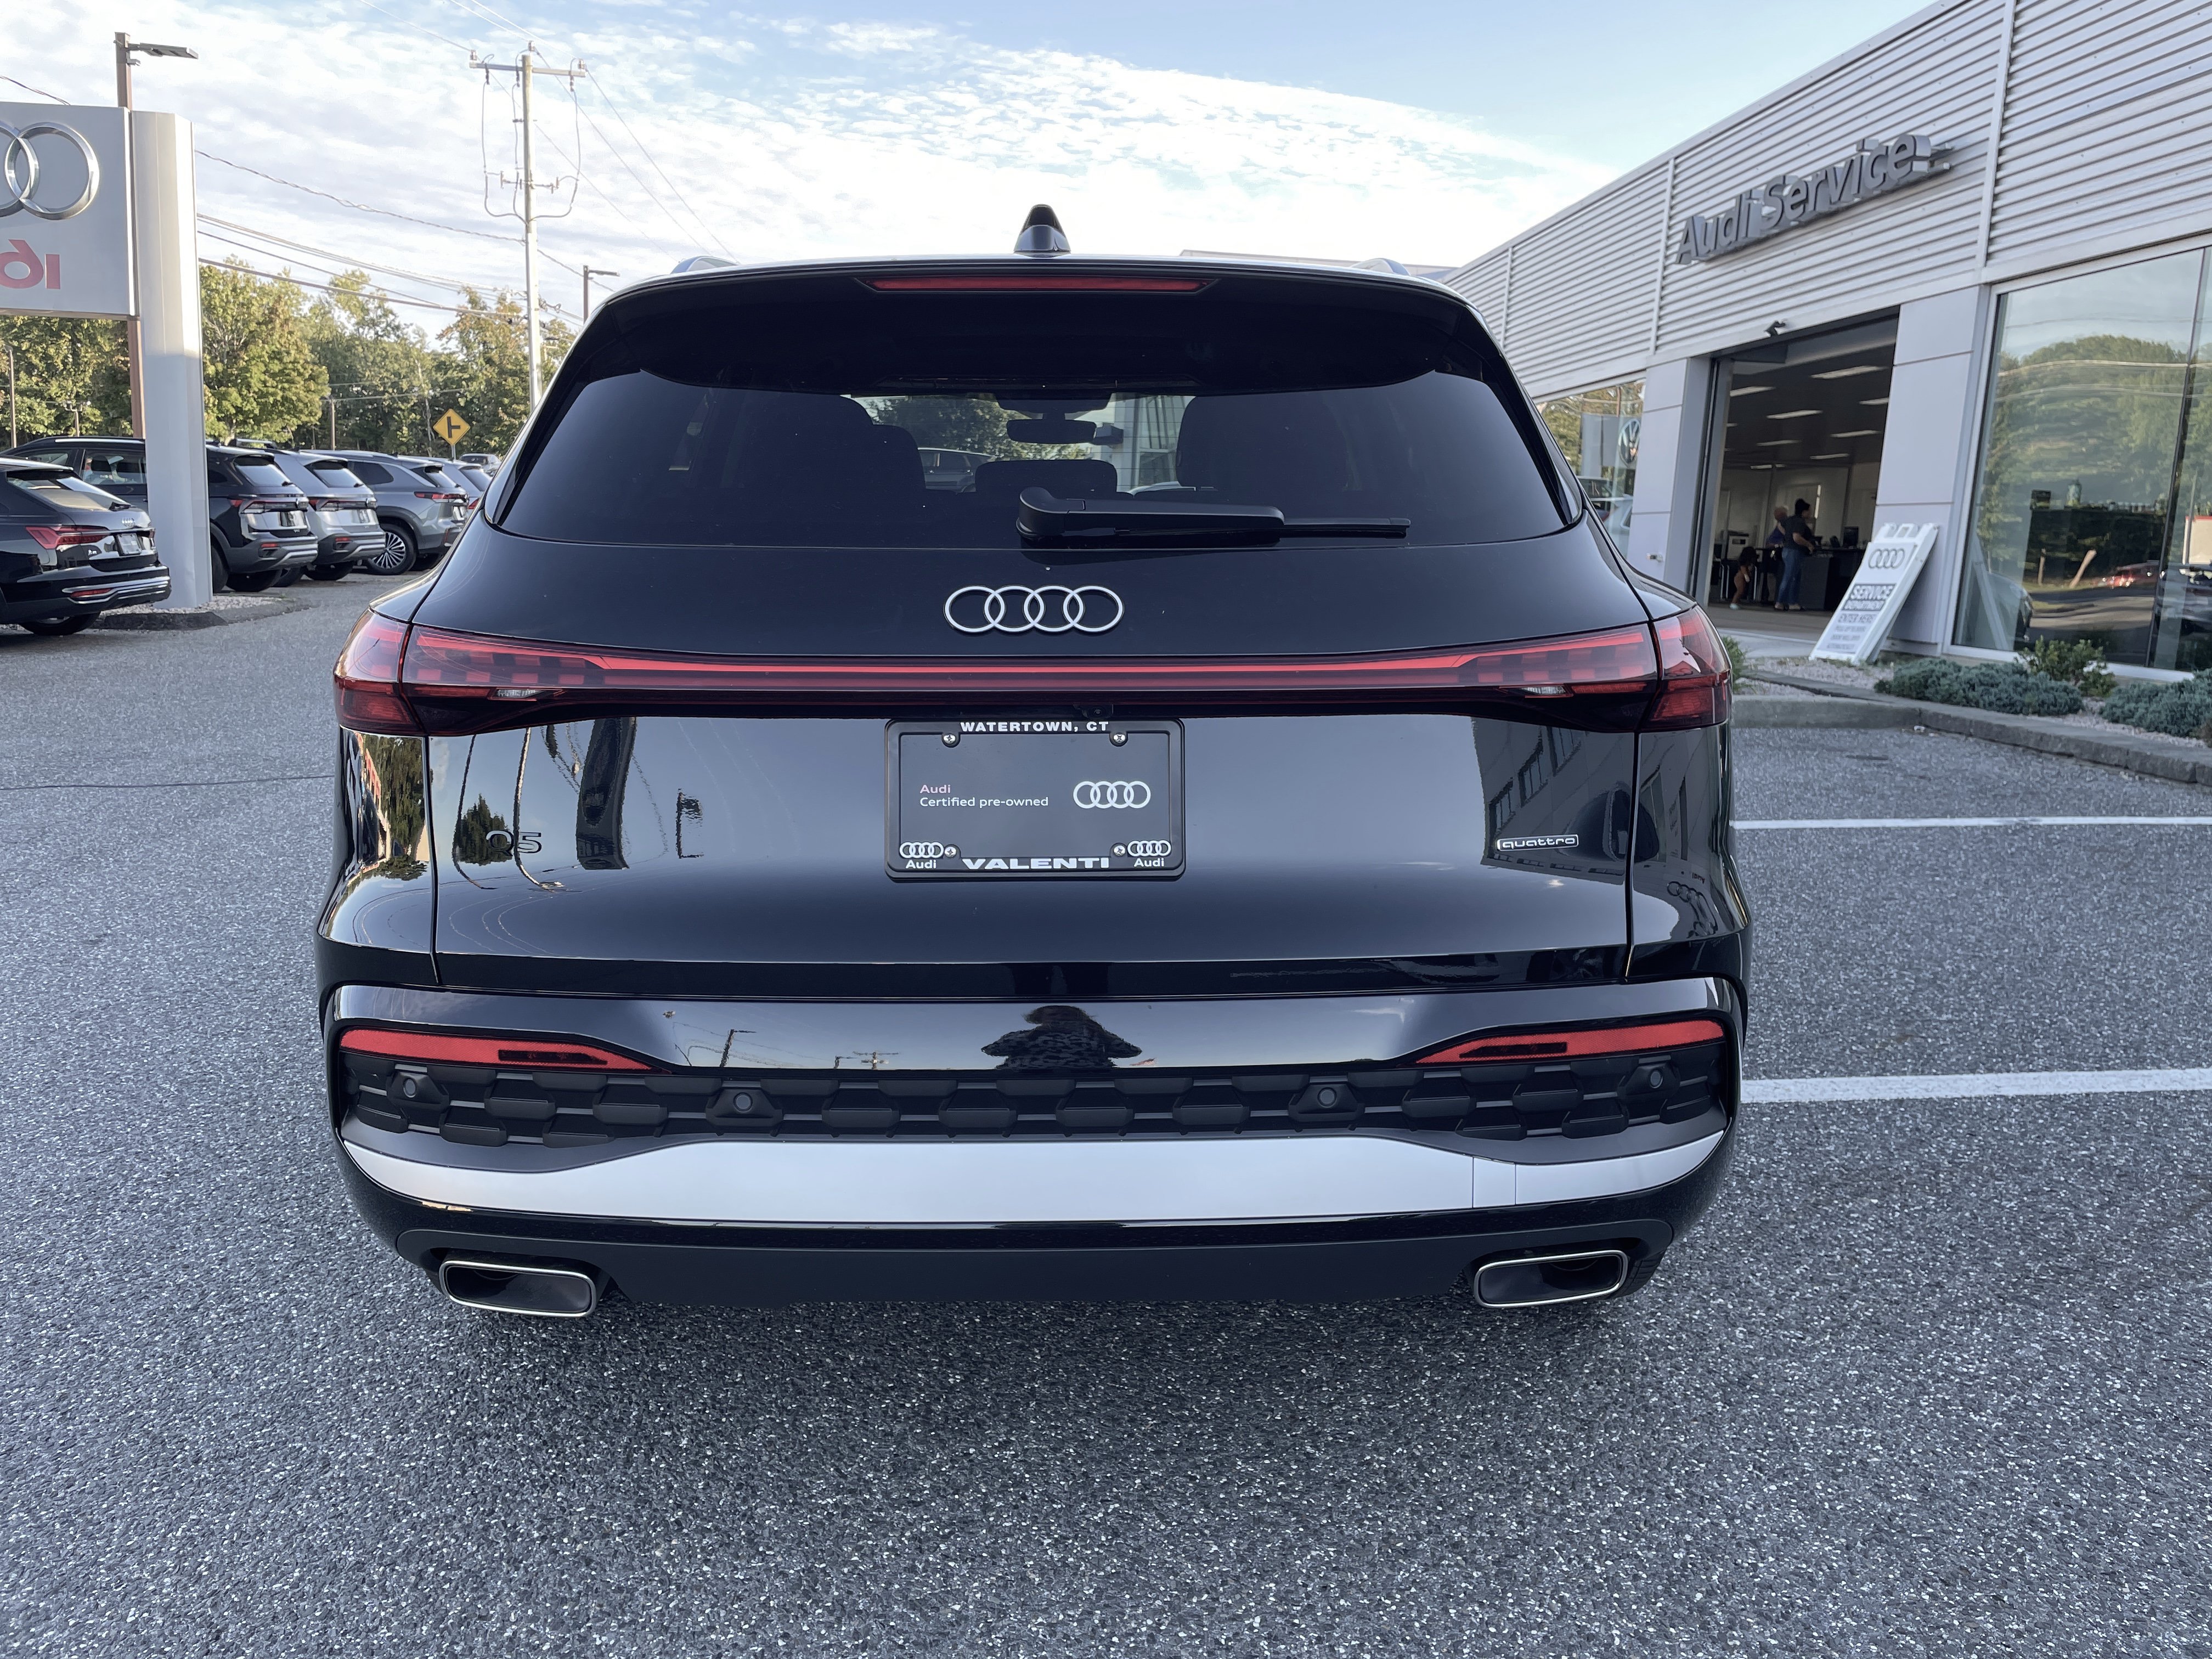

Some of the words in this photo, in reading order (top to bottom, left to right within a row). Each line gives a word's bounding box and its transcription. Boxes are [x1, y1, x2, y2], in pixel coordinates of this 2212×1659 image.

[1675, 189, 1762, 264] Audi
[1760, 134, 1931, 230] Service
[0, 239, 61, 290] di
[1848, 585, 1894, 600] SERVICE
[960, 721, 1079, 732] WATERTOWN,
[1086, 721, 1109, 731] CT
[919, 784, 951, 794] Audi
[919, 797, 975, 807] Certified
[979, 797, 1048, 809] pre-owned
[486, 830, 542, 856] Q5
[1502, 837, 1575, 849] quattro
[905, 859, 936, 870] Audi
[962, 857, 1110, 870] VALENTI
[1133, 857, 1165, 868] Audi
